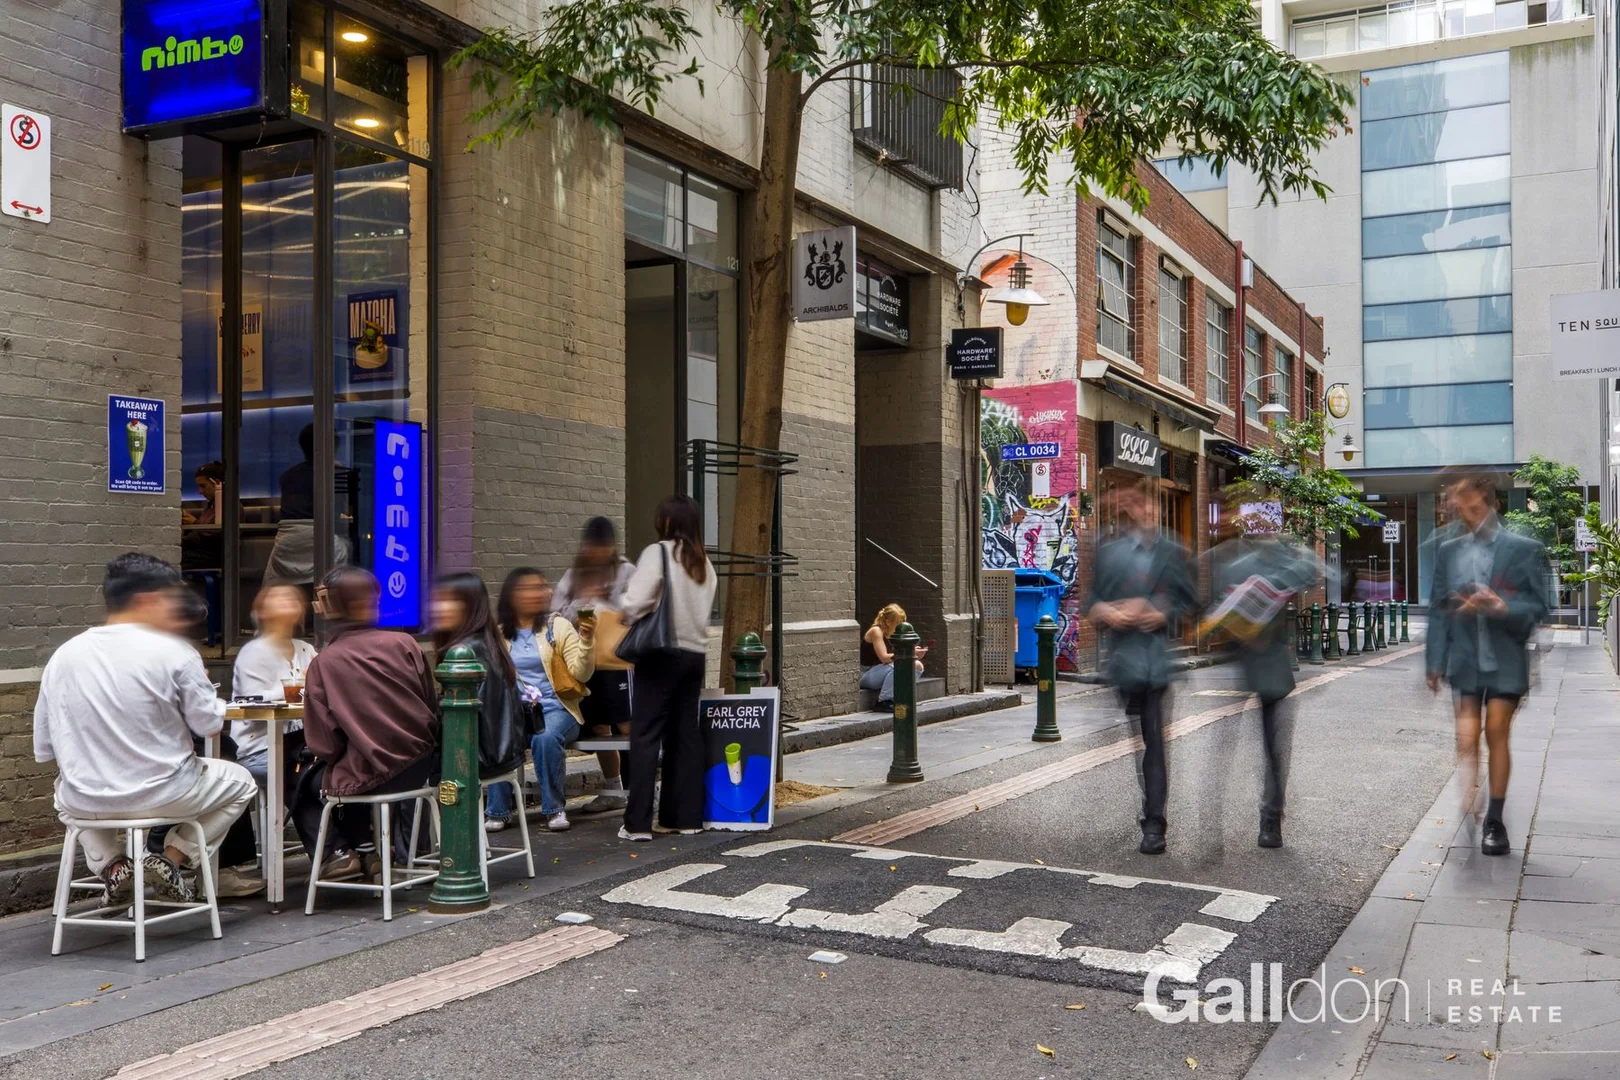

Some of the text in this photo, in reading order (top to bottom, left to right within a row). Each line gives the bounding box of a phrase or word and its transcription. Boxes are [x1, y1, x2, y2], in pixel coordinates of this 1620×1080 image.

[726, 256, 739, 271] 121
[802, 303, 849, 315] ARCHIBALDS
[350, 298, 396, 339] MATCHA
[1558, 317, 1620, 332] TEN SQU
[956, 347, 994, 355] HARDWARE
[961, 353, 990, 362] SOCIÉTÉ
[1560, 368, 1593, 376] BREAKFAST
[115, 400, 158, 412] TAKEAWAY
[127, 410, 147, 420] HERE
[1015, 445, 1056, 456] CL 0034
[706, 706, 767, 718] EARL GREY
[711, 718, 761, 729] MATCHA
